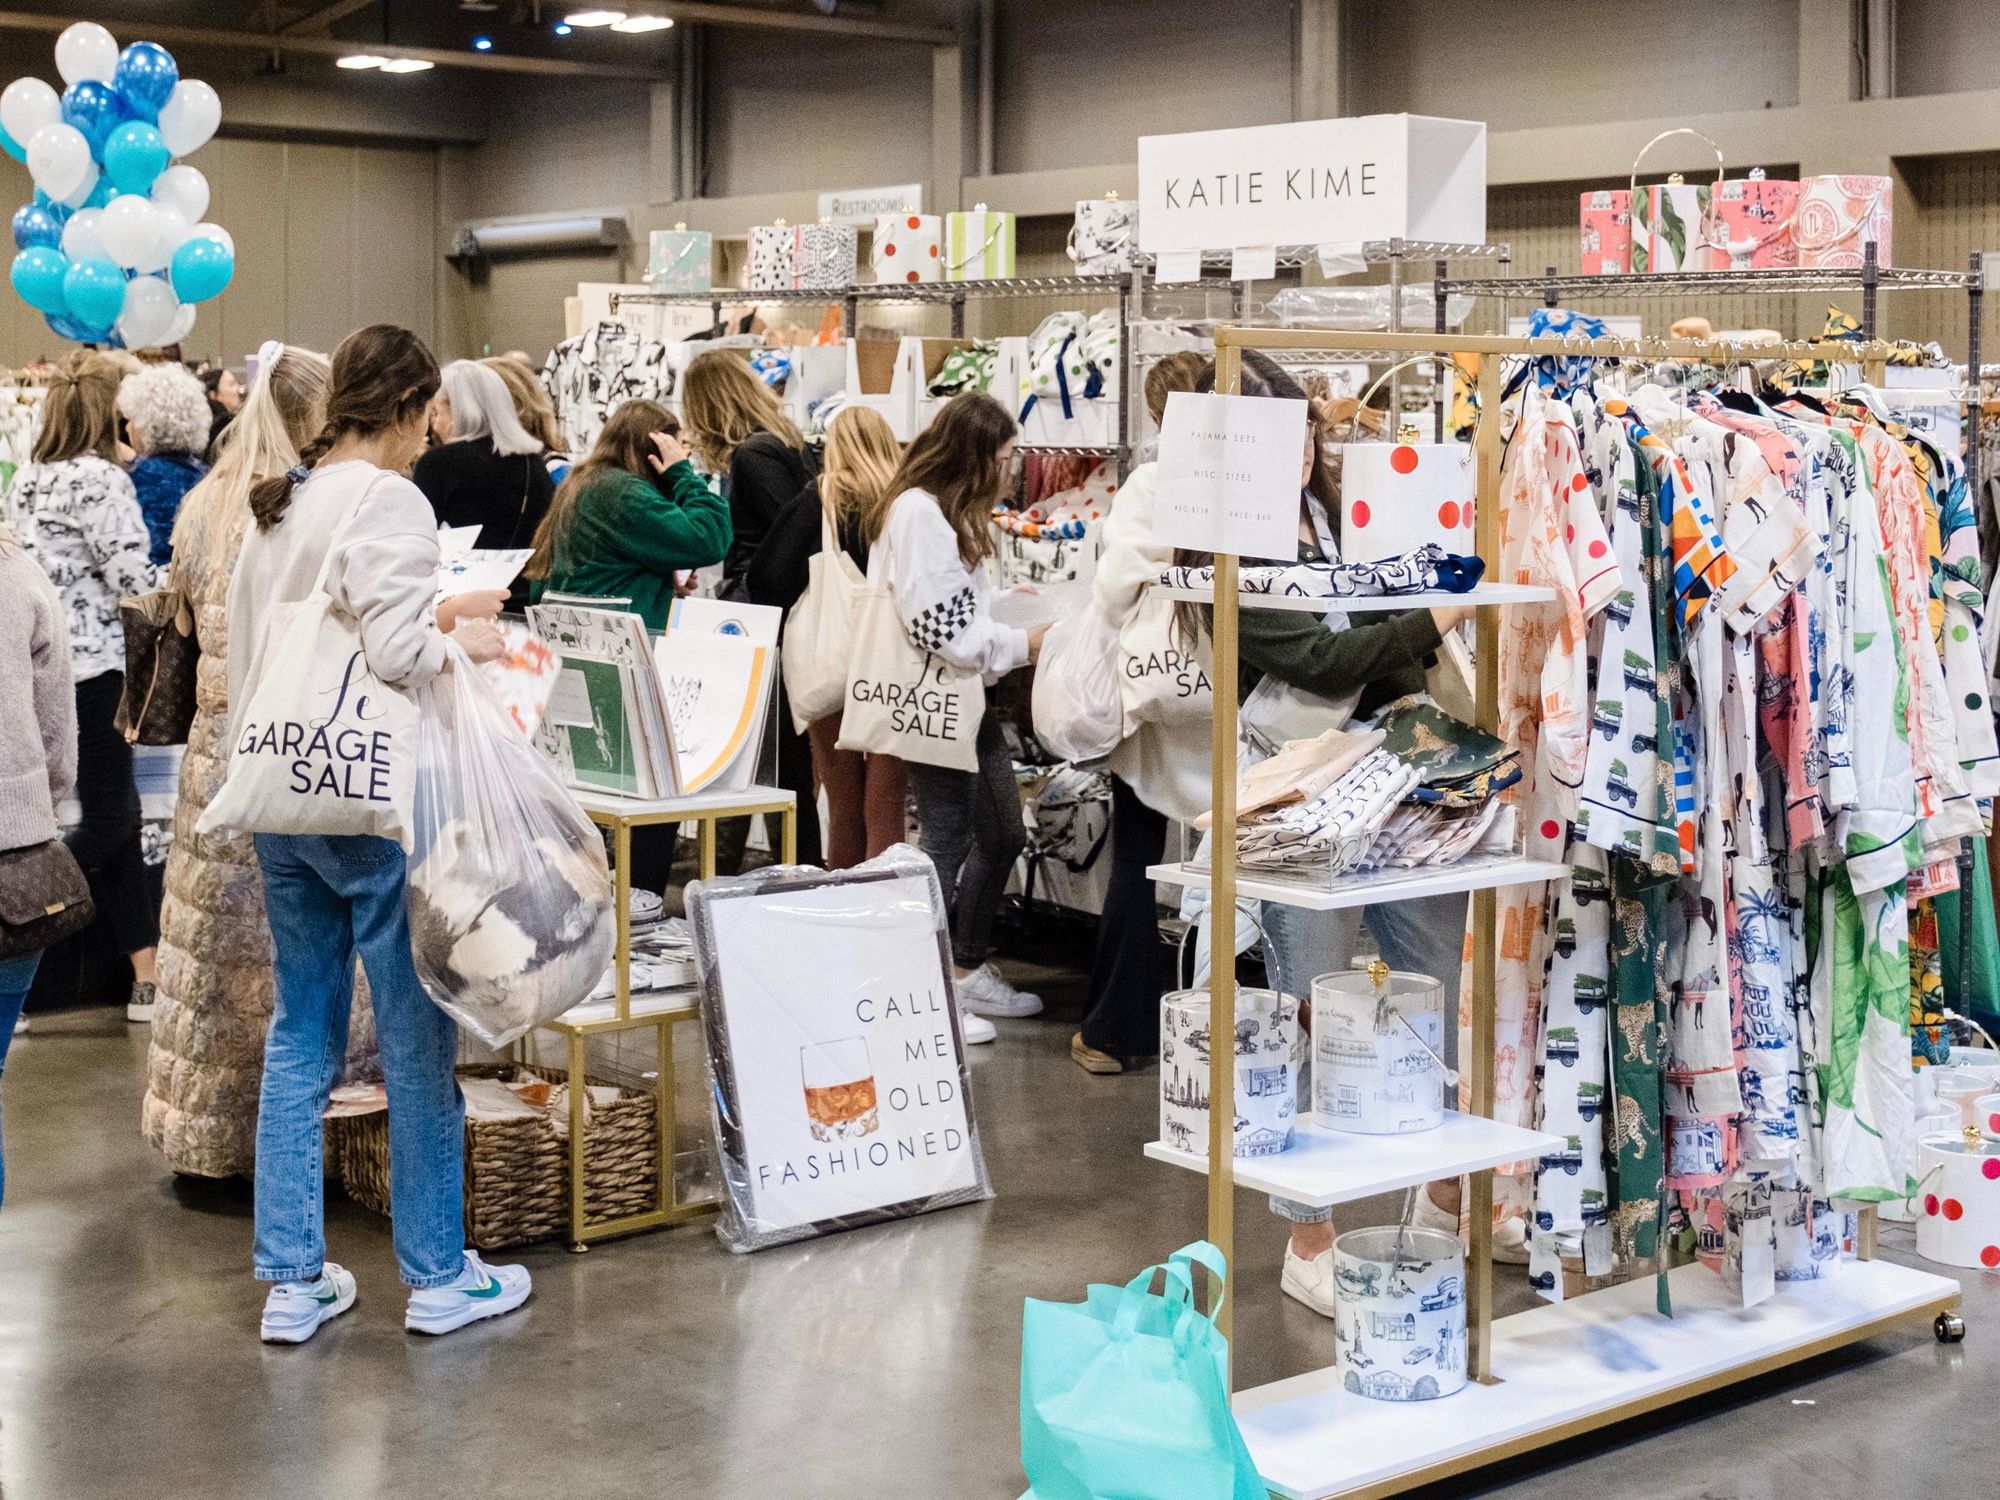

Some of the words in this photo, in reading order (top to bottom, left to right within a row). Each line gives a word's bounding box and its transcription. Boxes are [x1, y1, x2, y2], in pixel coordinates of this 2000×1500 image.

[1165, 172, 1262, 209] KATIE
[1285, 163, 1376, 201] KIME
[1190, 430, 1228, 441] PAJAMA
[1233, 434, 1256, 444] SETS
[1225, 472, 1252, 483] SIZES
[852, 679, 960, 716] GARAGE
[1176, 670, 1212, 697] SA
[890, 709, 958, 741] SALE
[238, 721, 392, 766] GARAGE
[289, 760, 392, 802] SALE
[856, 990, 940, 1022] CALL
[905, 1034, 948, 1062] ME
[889, 1080, 954, 1111] OLD
[759, 1128, 962, 1190] FASHIONED
